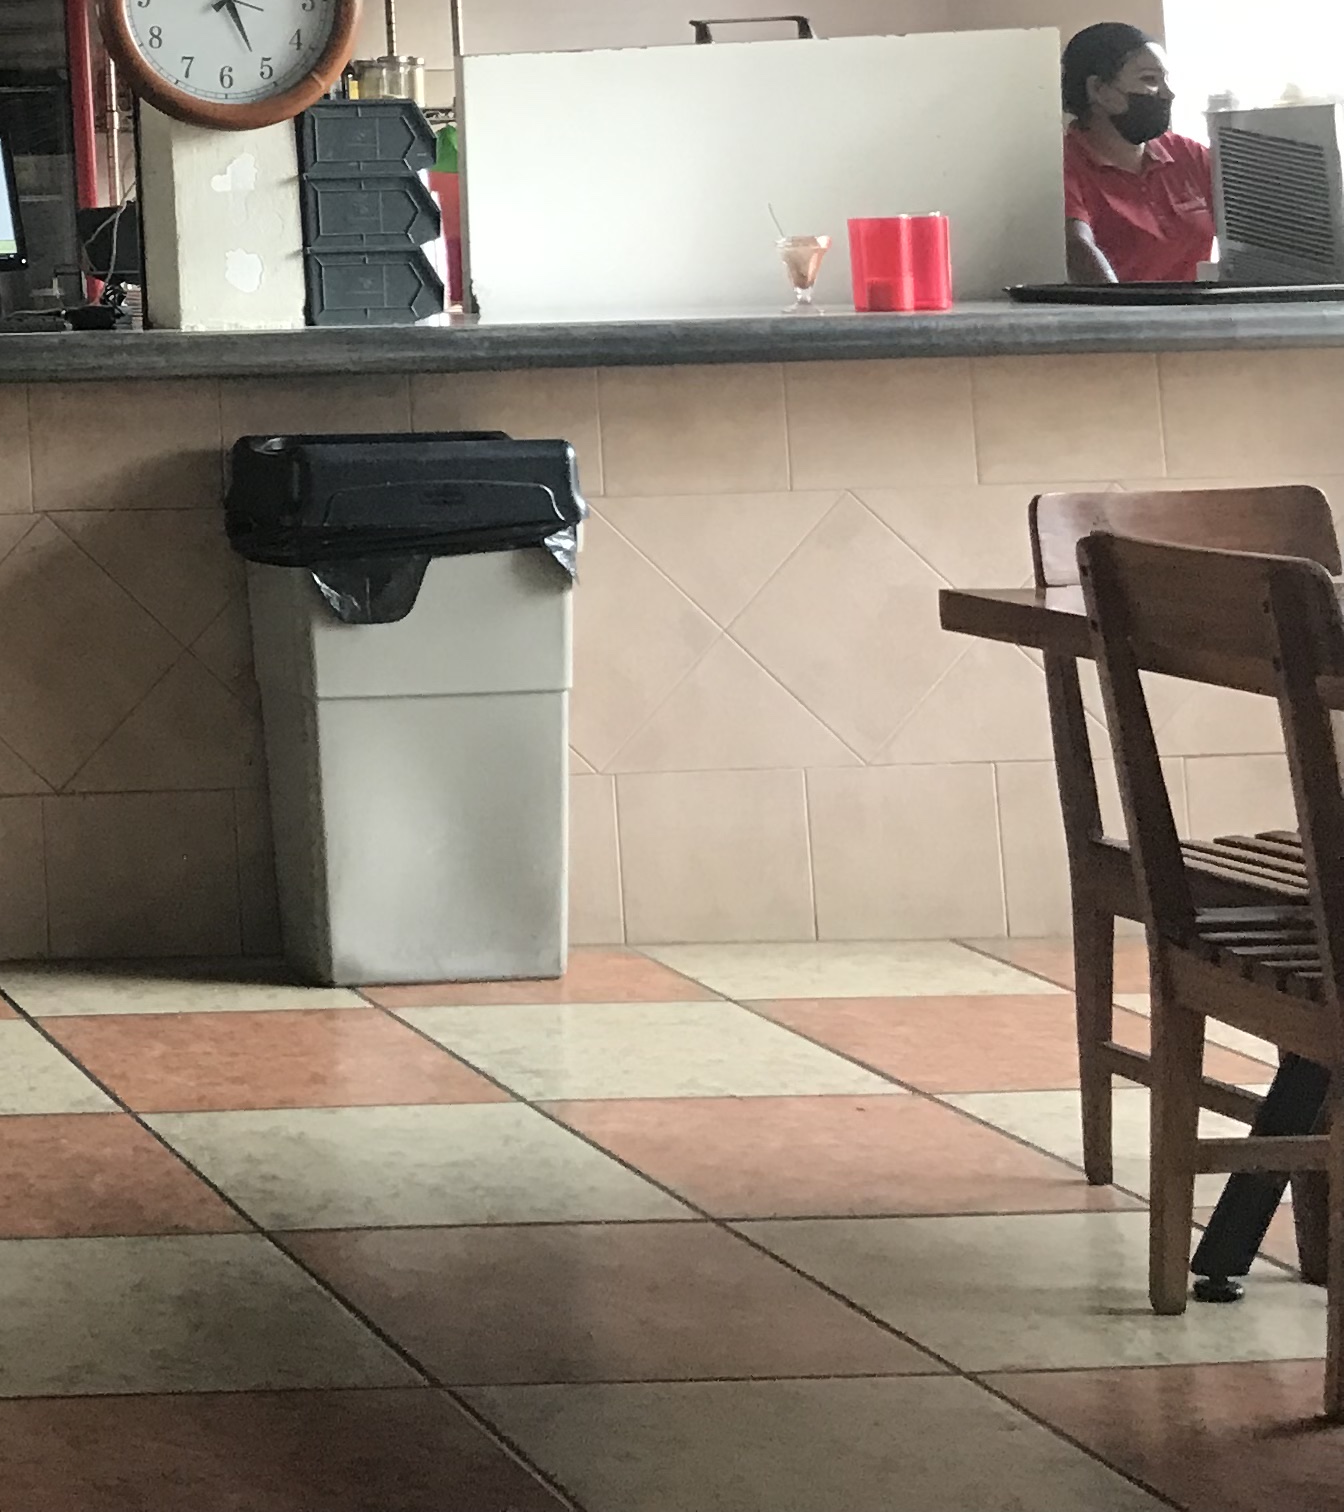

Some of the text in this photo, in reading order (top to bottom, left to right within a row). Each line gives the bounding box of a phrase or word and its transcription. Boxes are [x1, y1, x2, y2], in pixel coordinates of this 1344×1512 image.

[149, 26, 162, 48] 8
[289, 28, 303, 51] 4
[182, 56, 194, 78] 7
[220, 66, 233, 88] 6
[260, 57, 273, 79] 5
